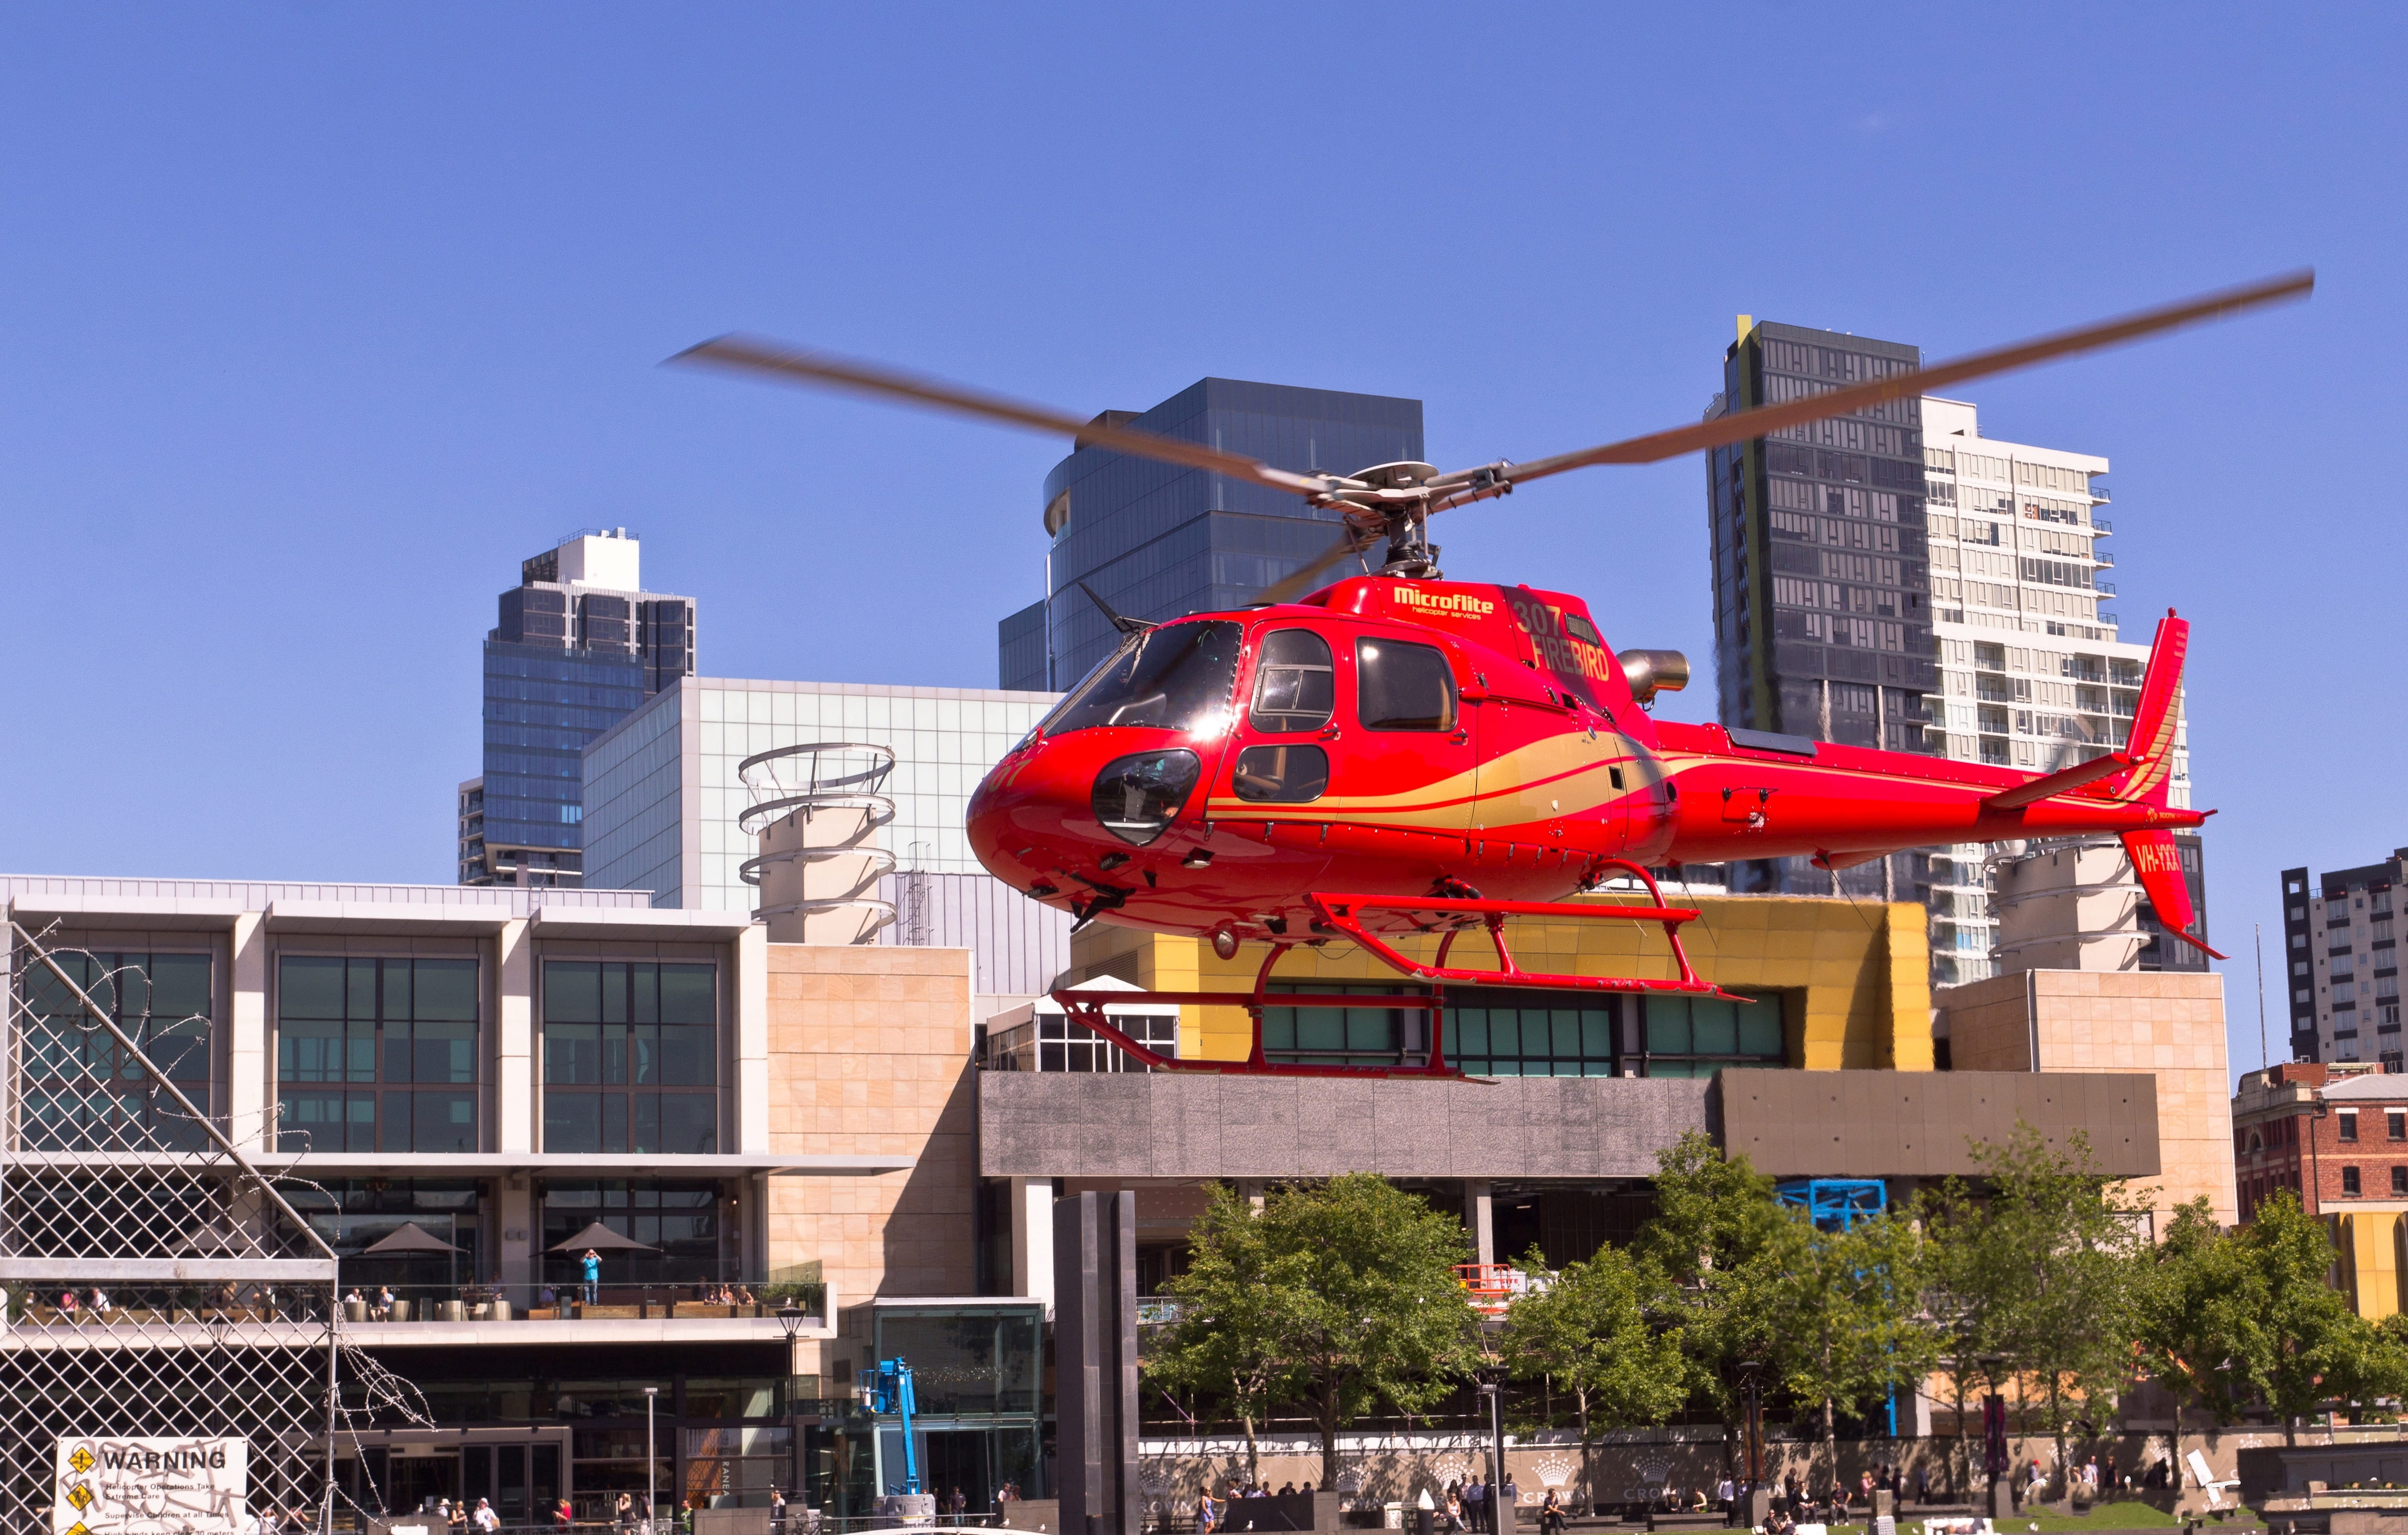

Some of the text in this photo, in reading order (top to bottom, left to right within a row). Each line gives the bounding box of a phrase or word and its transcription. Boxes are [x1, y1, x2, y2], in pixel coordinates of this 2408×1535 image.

[1394, 586, 1494, 614] Microflite
[1412, 606, 1481, 620] helicopter services
[1513, 601, 1561, 636] 307
[1530, 634, 1609, 682] FIREBIRD
[104, 1451, 225, 1469] WARNING
